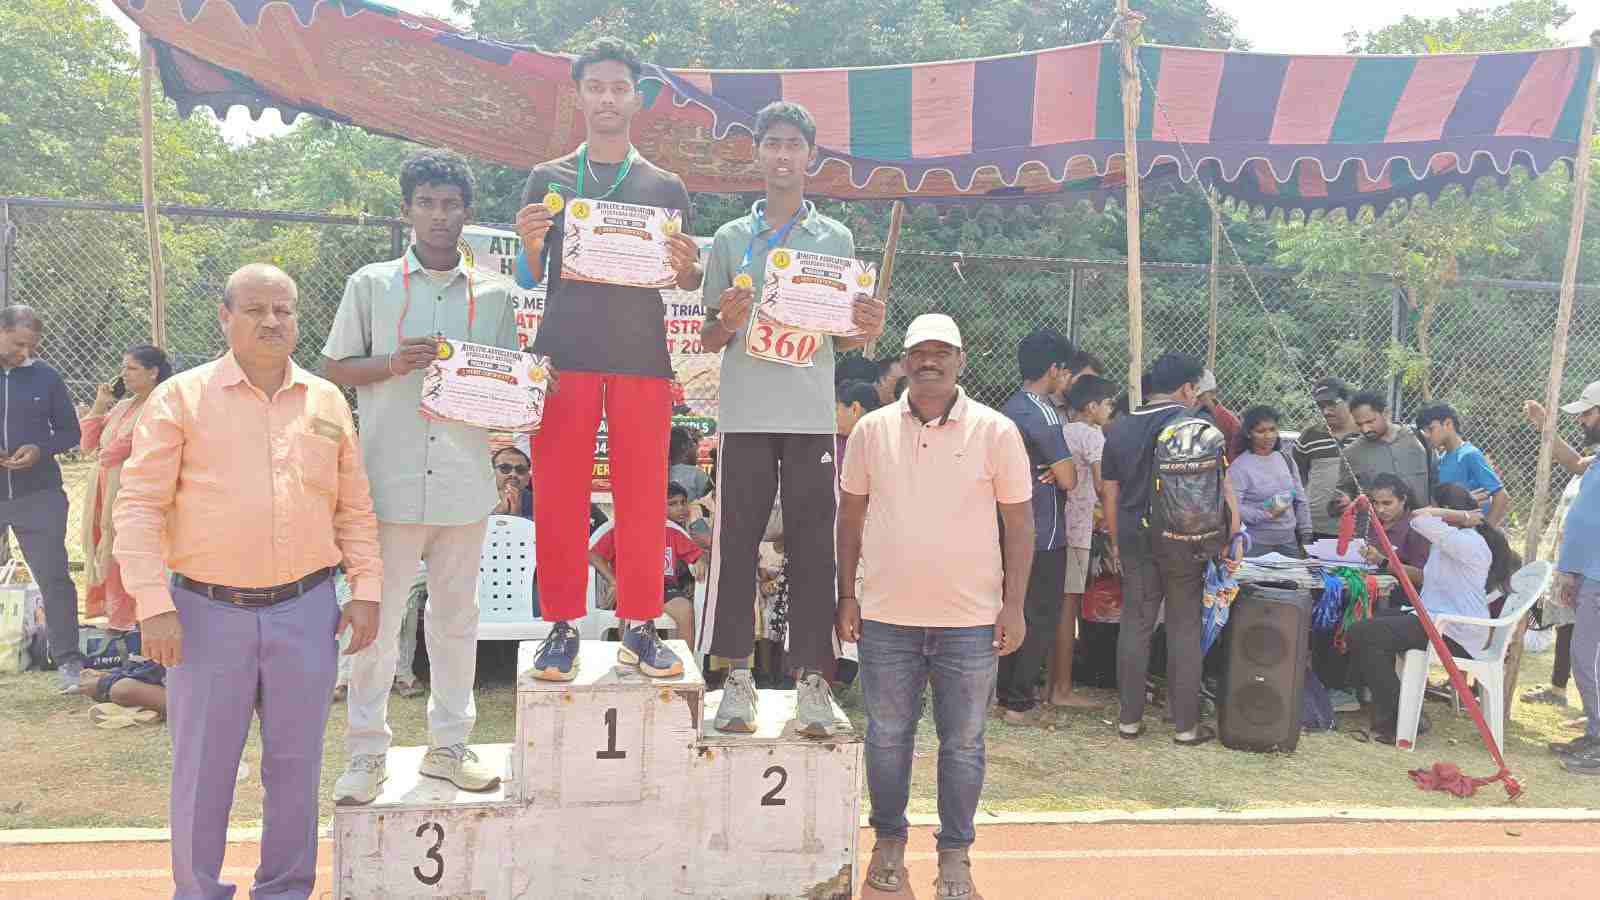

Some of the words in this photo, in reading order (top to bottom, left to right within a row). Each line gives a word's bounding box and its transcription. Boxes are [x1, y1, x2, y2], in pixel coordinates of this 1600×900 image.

[752, 325, 816, 361] 360
[596, 708, 626, 759] 1
[760, 766, 788, 806] 2
[413, 822, 445, 886] 3
